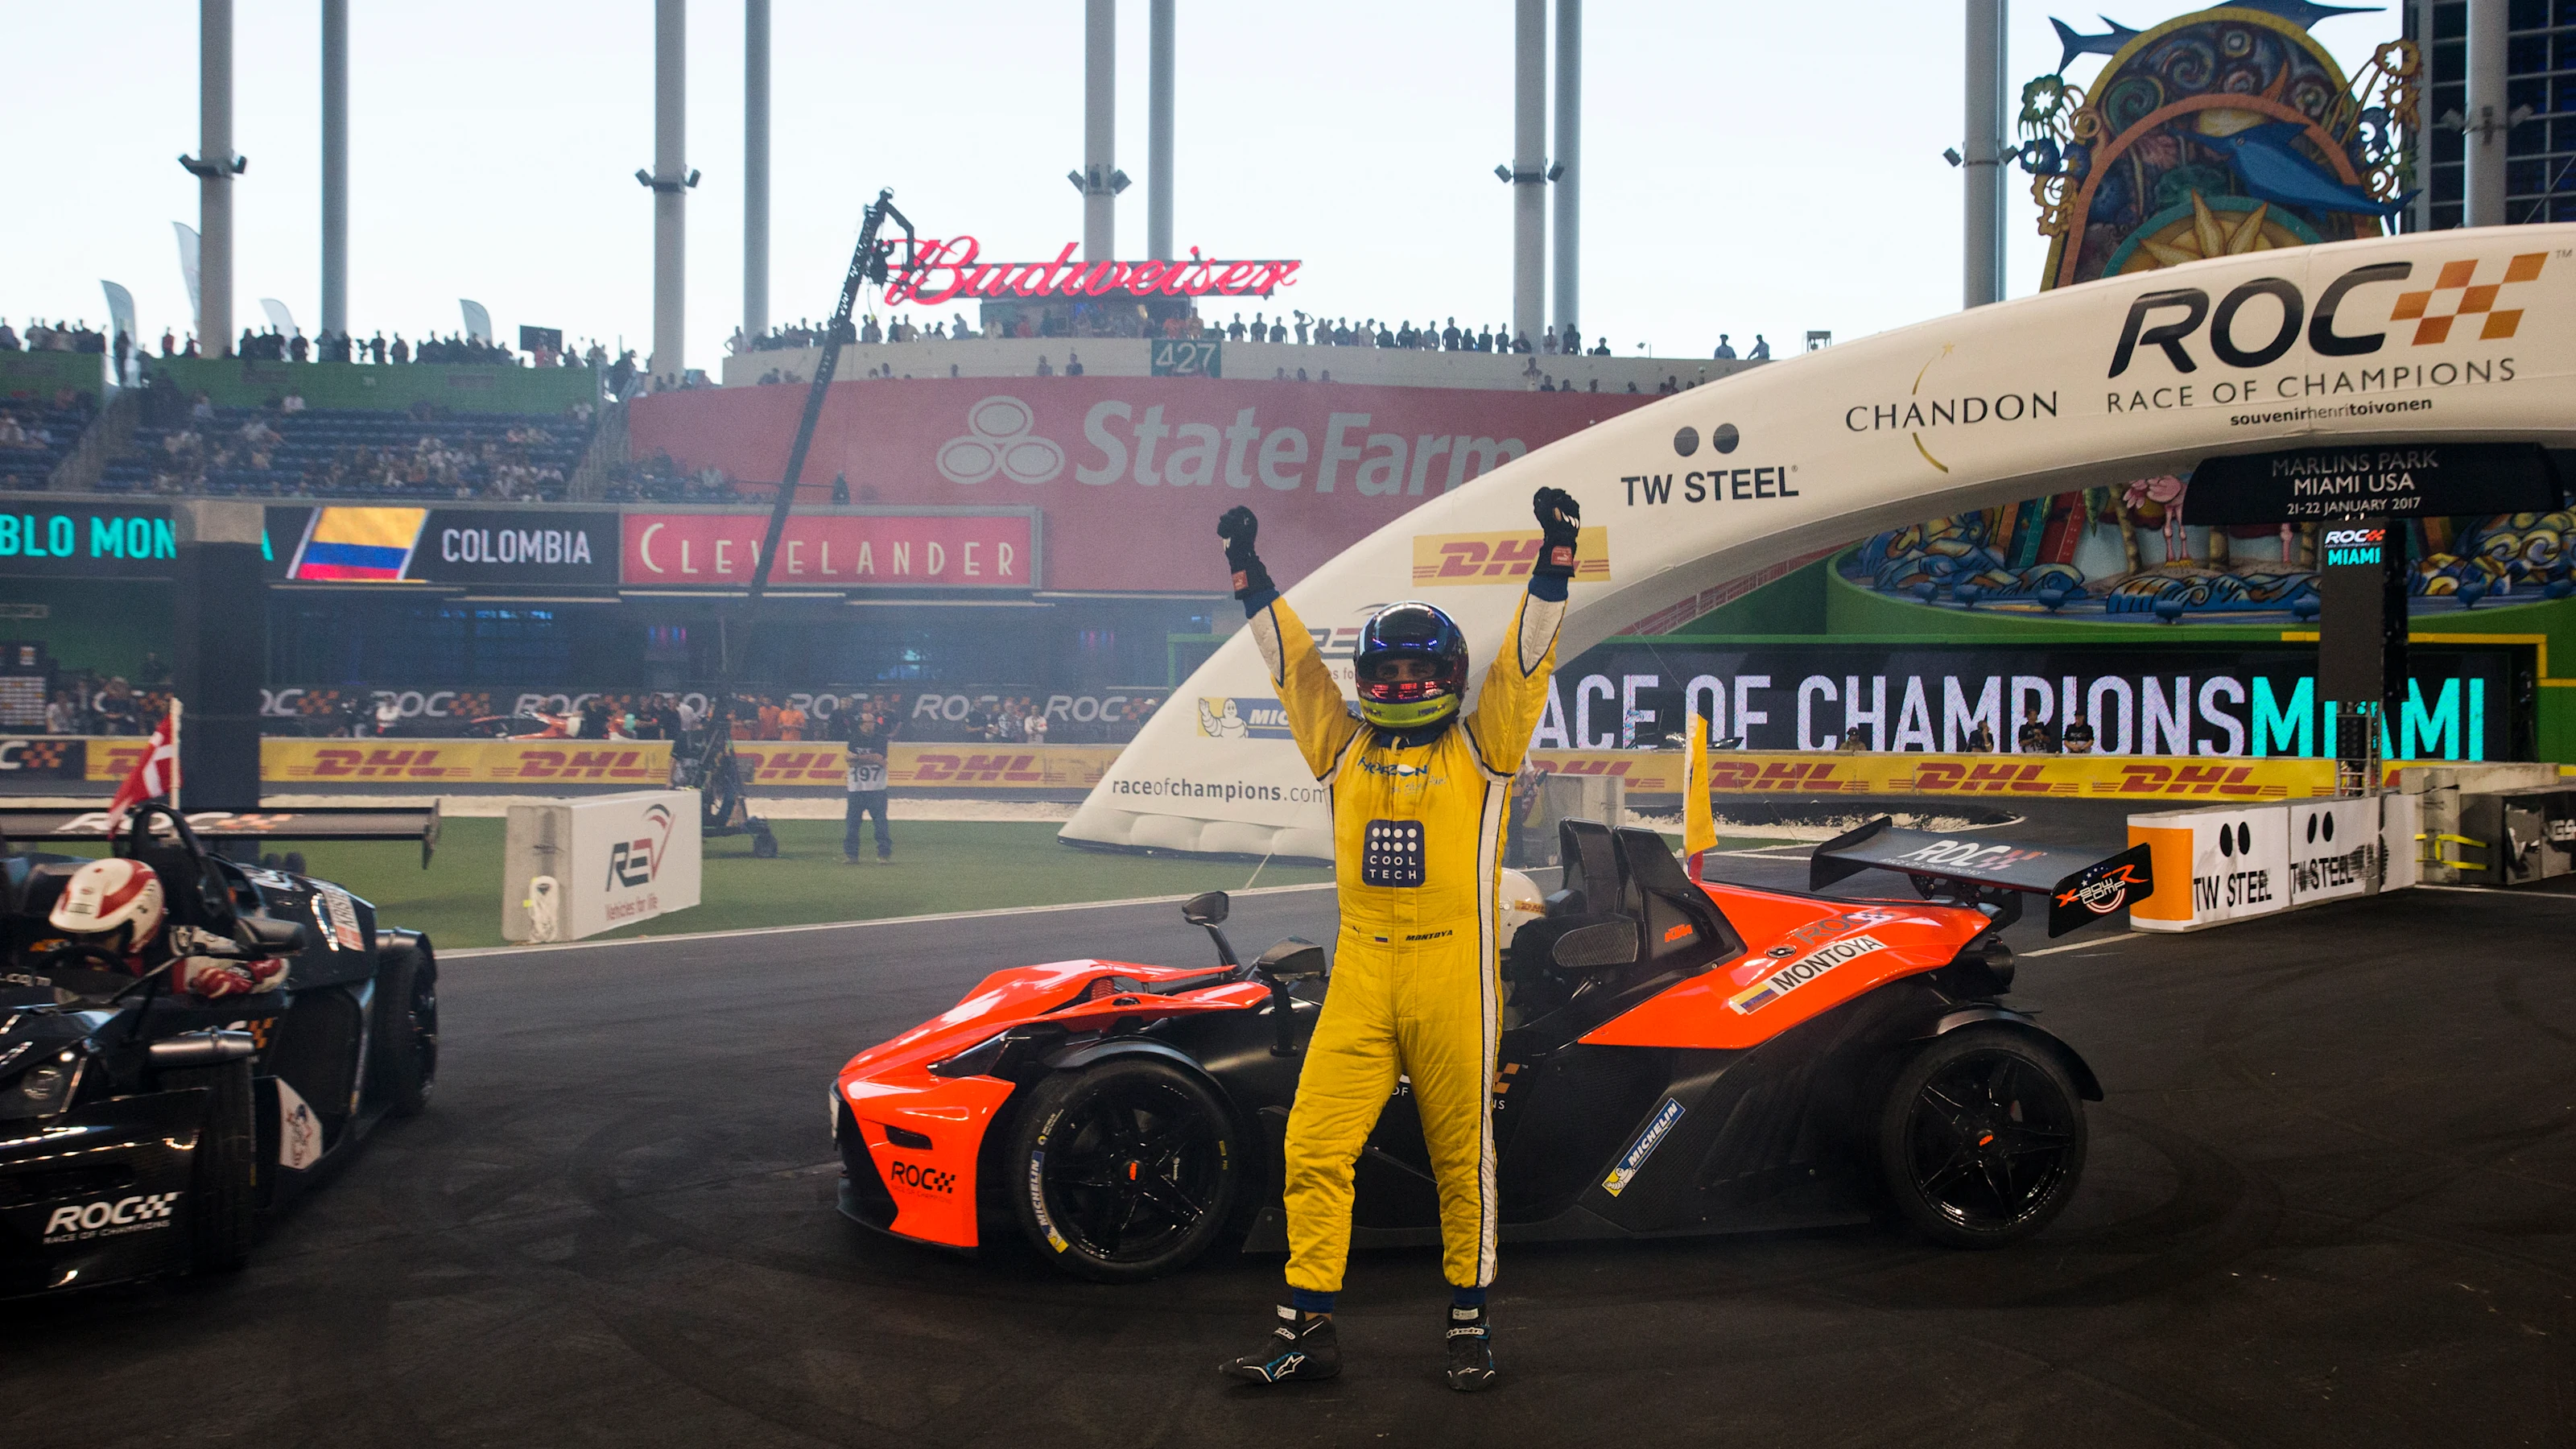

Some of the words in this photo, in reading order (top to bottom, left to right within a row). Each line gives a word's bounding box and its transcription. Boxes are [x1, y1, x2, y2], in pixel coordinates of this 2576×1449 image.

[884, 235, 1302, 306] Budweiser
[2107, 262, 2413, 378] ROC
[1155, 342, 1217, 374] 427
[2107, 386, 2194, 412] RACE
[2213, 380, 2257, 403] OF
[2277, 357, 2516, 398] CHAMPIONS
[1846, 390, 2058, 431] CHANDON
[2231, 398, 2432, 426] souvenirhenritoivonen
[2273, 453, 2371, 477] MARLINS
[2378, 449, 2439, 471] PARK
[1620, 473, 1673, 506] TW
[2294, 475, 2360, 497] MIAMI
[2369, 472, 2415, 492] USA
[2286, 502, 2320, 515] 21-22
[2323, 498, 2388, 516] JANUARY
[2392, 496, 2421, 510] 2017
[442, 528, 592, 564] COLOMBIA
[2325, 529, 2370, 544] ROC
[1433, 539, 1581, 577] DH
[2327, 547, 2381, 566] MIAMI
[1046, 695, 1127, 722] ROC
[1529, 674, 1659, 749] ACE
[1685, 674, 1771, 750] OF
[312, 749, 447, 778] DHL
[518, 750, 650, 778] DHL
[850, 766, 881, 782] 197
[913, 754, 1043, 782] DHL
[1711, 761, 1844, 791] DHL
[1915, 762, 2054, 793] DHL
[2119, 764, 2262, 795] DHL
[1369, 854, 1416, 866] COOL
[1897, 840, 2012, 867] ROC
[1369, 869, 1417, 880] TECH
[2193, 875, 2220, 912] TW
[2227, 869, 2273, 908] STEEL
[1406, 929, 1454, 942] MONTOYA
[1665, 923, 1693, 943] KTM
[1770, 937, 1884, 992] MONTOYA
[1627, 1102, 1678, 1167] MICHELIN
[890, 1160, 936, 1191] ROC
[1030, 1158, 1049, 1227] MICHELIN
[43, 1195, 145, 1235] ROC
[43, 1233, 77, 1245] RACE
[79, 1230, 98, 1241] OF
